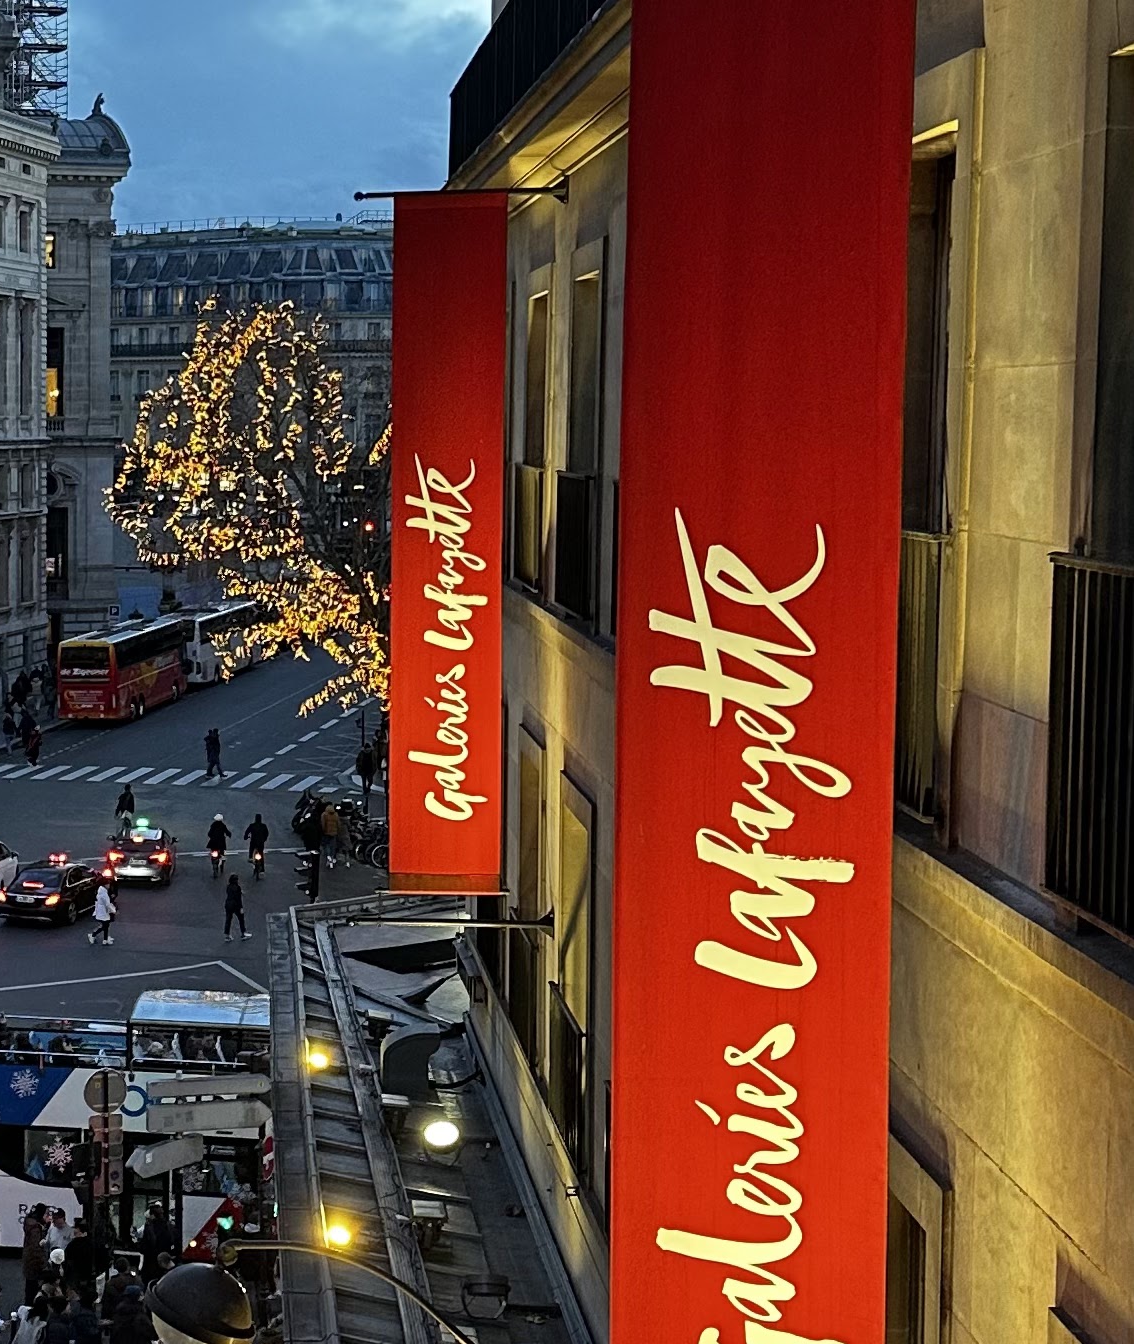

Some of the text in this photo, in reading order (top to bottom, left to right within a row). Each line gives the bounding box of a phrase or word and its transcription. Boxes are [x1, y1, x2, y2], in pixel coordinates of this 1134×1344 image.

[405, 454, 487, 820] Galeries Lafayette
[649, 508, 854, 989] Lafayette
